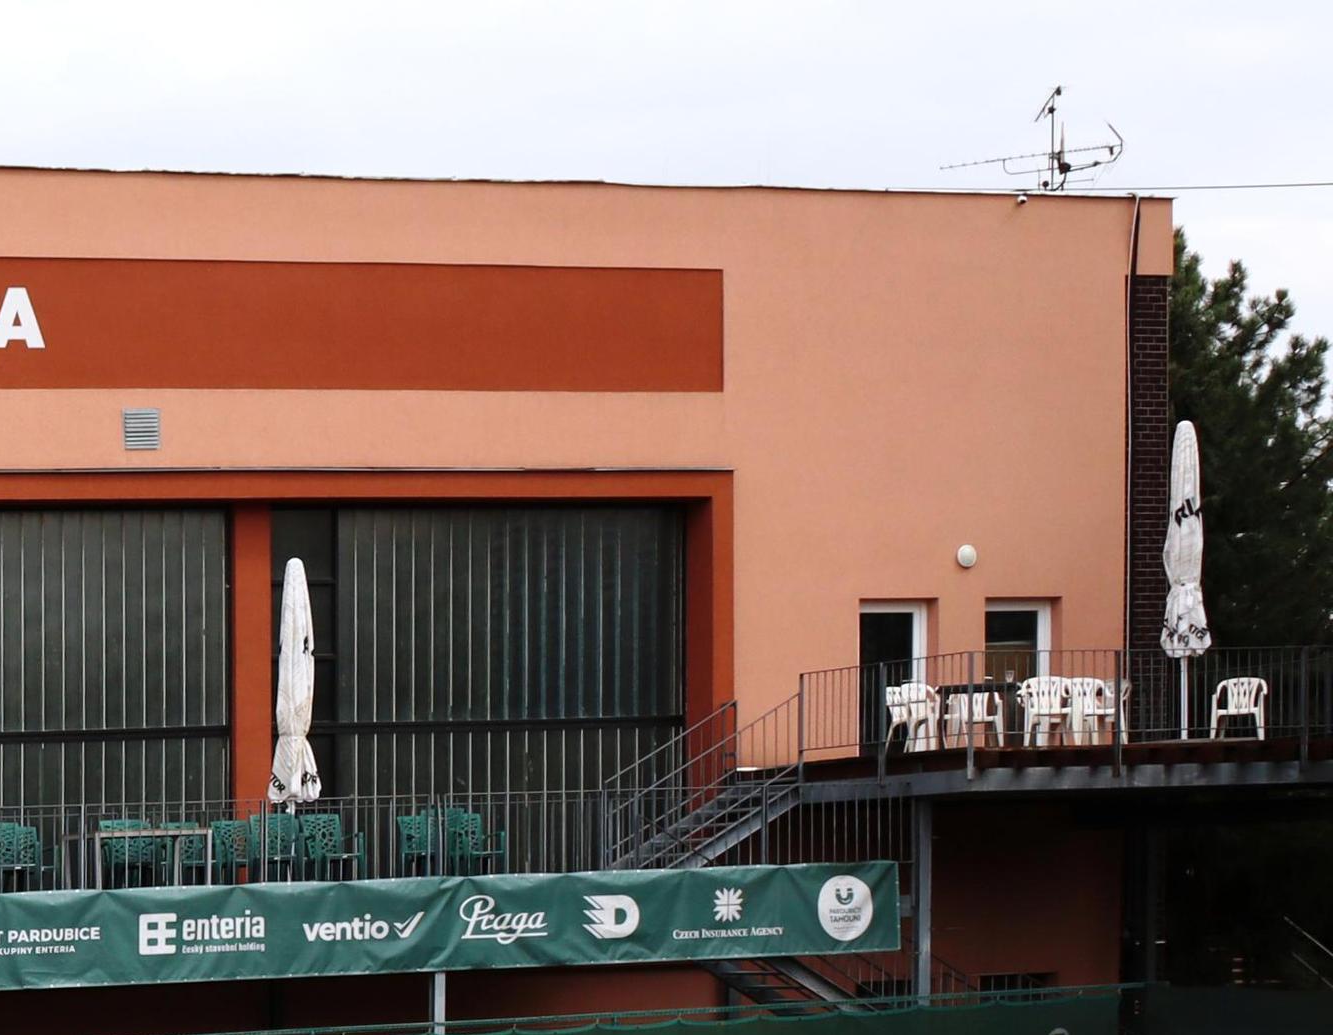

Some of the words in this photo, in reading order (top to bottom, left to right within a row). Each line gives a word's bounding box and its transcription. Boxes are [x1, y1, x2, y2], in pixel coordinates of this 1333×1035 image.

[182, 909, 266, 941] enteria
[302, 913, 390, 942] ventio
[459, 894, 548, 945] Praga
[8, 926, 101, 943] PARDUBICE
[35, 944, 76, 954] ENTERIA
